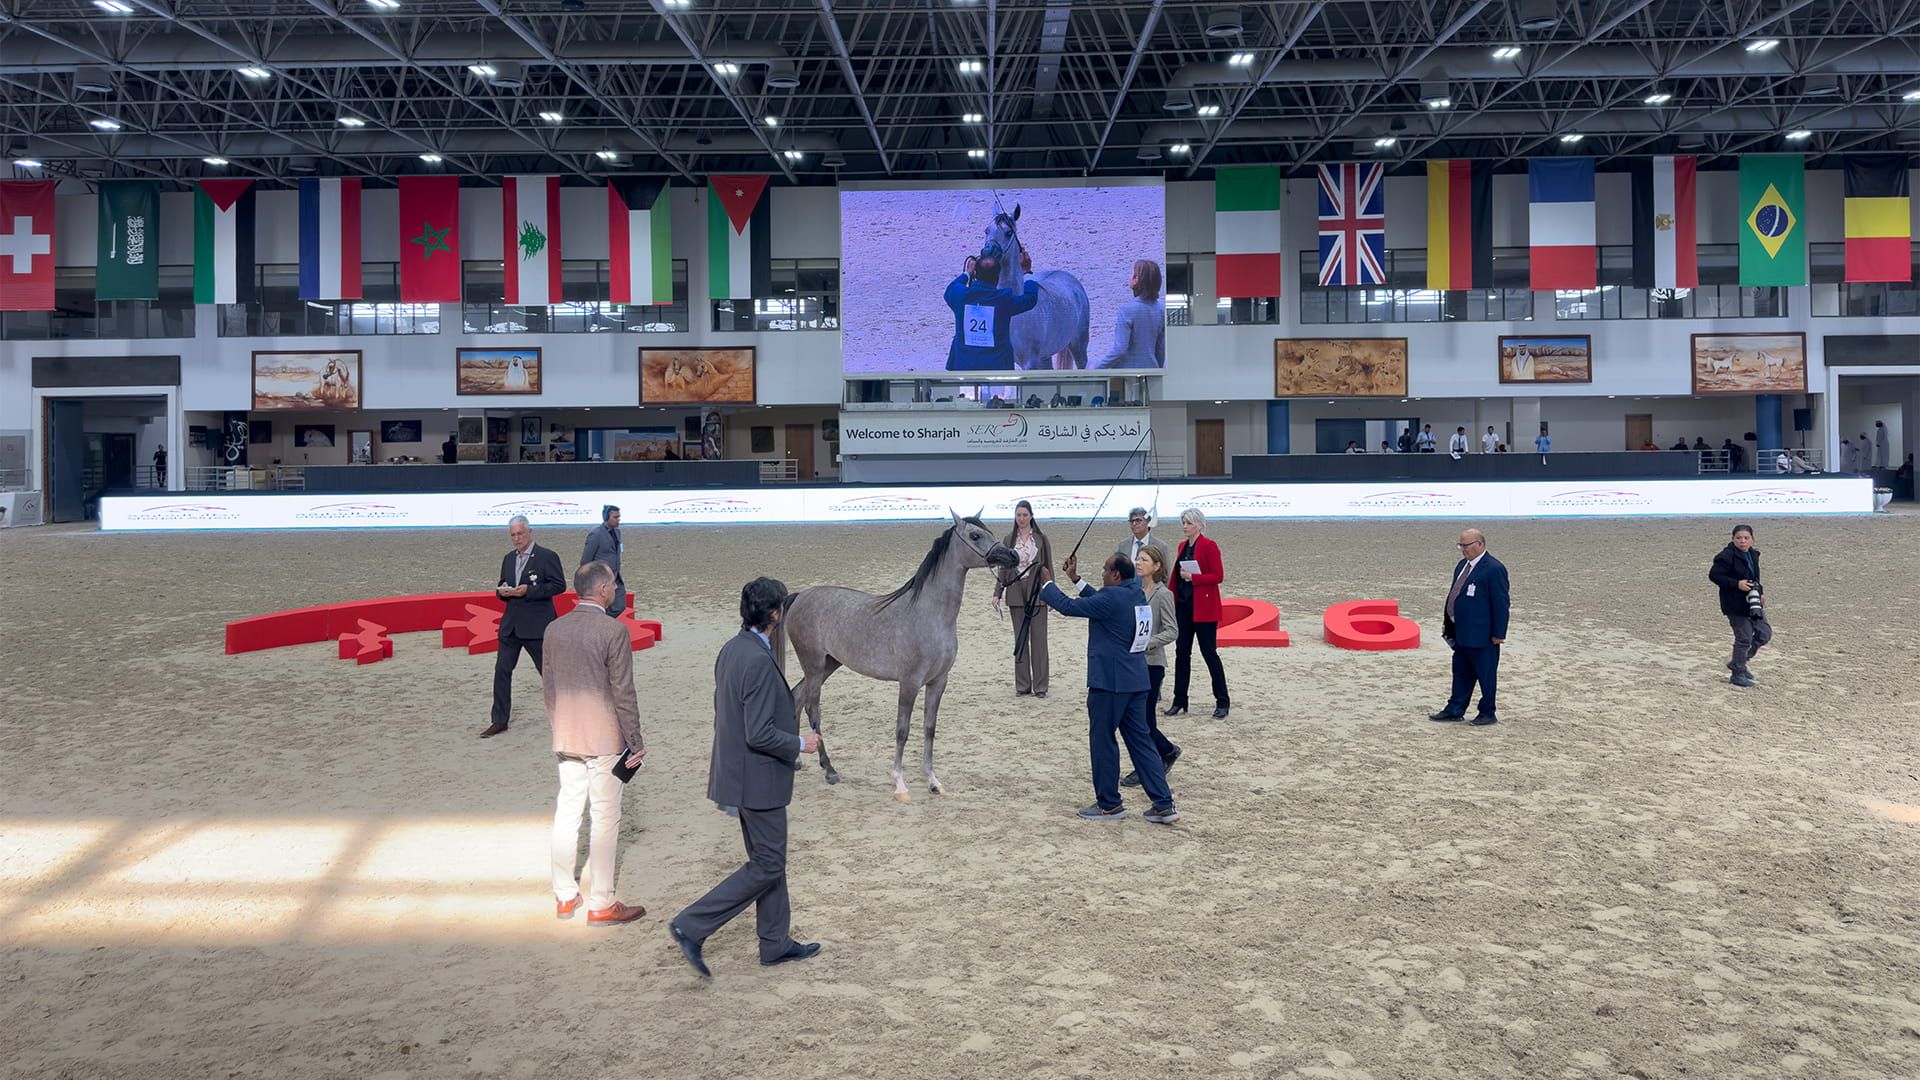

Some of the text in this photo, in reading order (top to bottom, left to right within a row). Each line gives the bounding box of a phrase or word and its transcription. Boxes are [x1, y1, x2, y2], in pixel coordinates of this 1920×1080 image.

[970, 318, 987, 333] 24
[846, 428, 960, 440] Welcome to Sharjah
[967, 424, 1003, 436] SERC
[1038, 424, 1077, 440] الشارقة
[1080, 424, 1090, 442] في
[1094, 424, 1116, 442] بكم
[1138, 620, 1150, 636] 24
